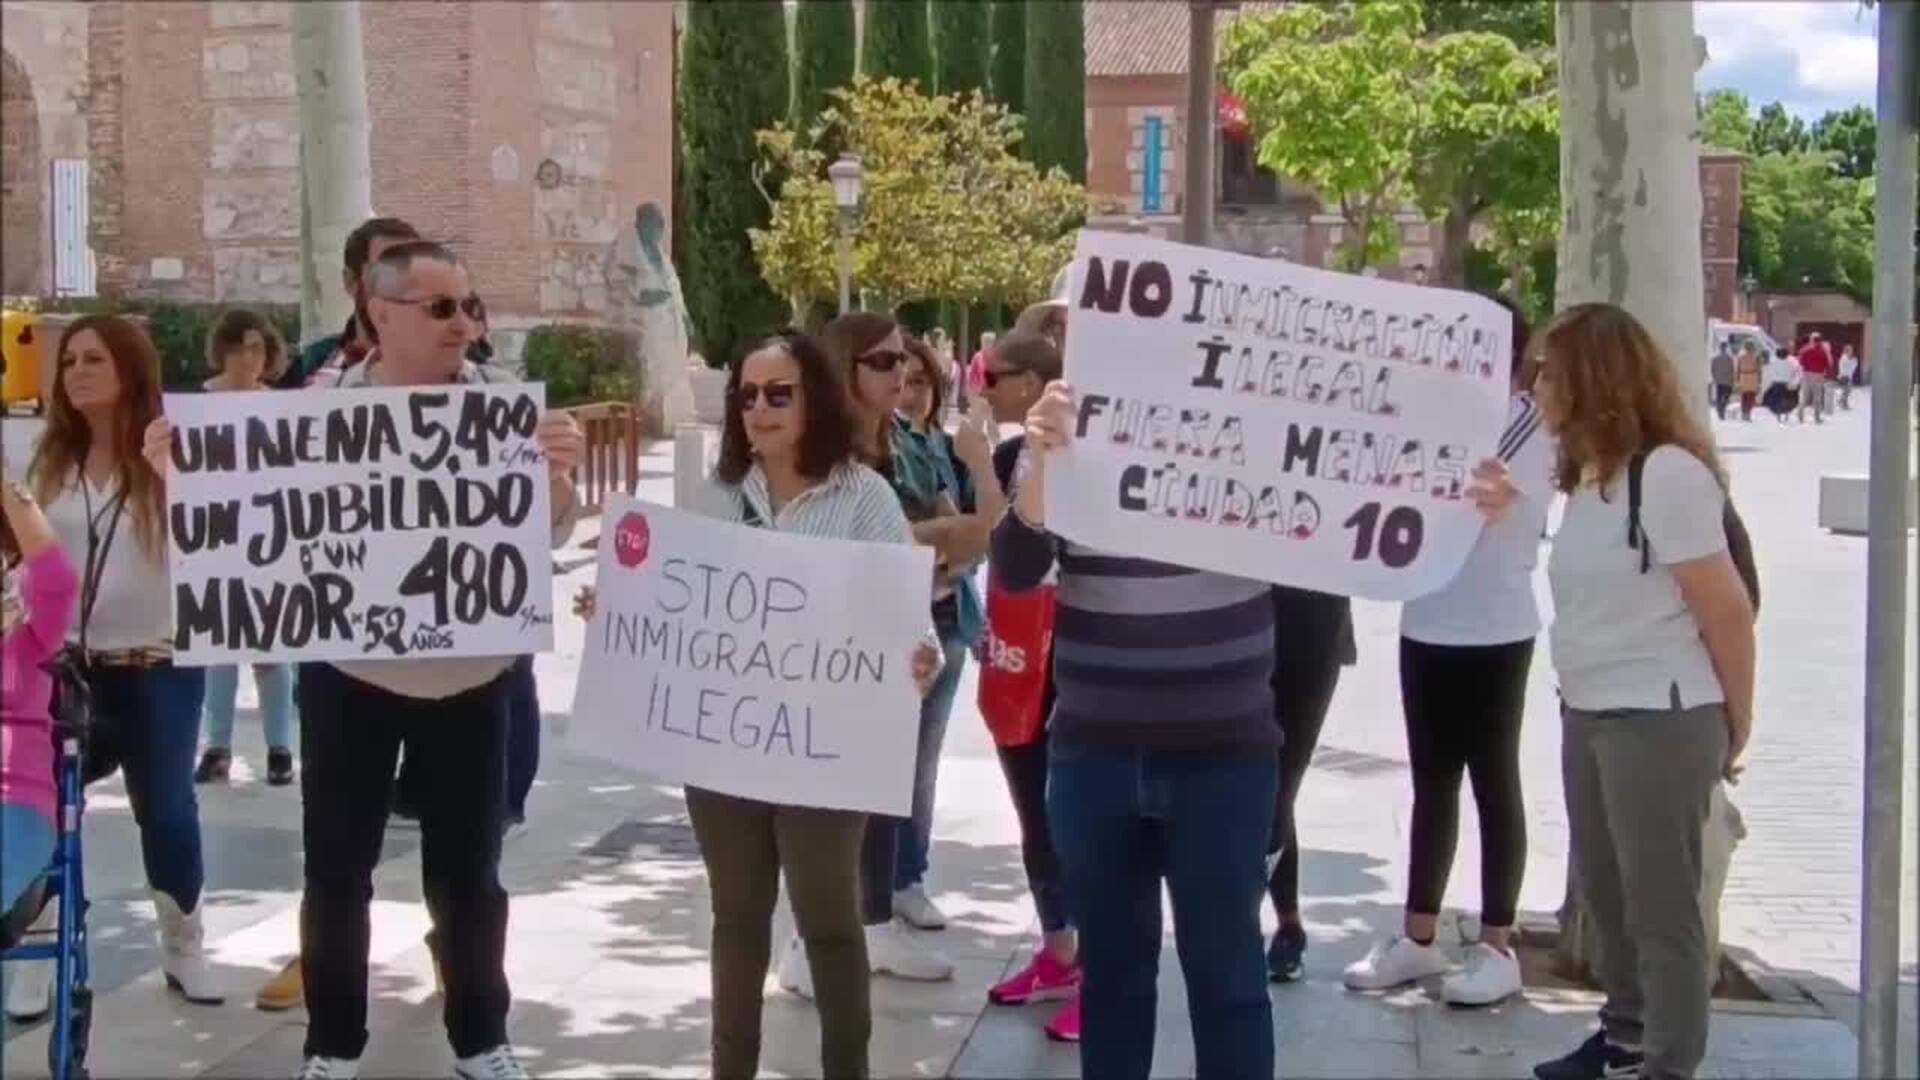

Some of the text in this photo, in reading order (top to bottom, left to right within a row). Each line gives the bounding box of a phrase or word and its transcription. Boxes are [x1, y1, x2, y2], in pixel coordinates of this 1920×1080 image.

[1080, 256, 1172, 318] NO
[1075, 395, 1466, 501] FUERA MENAS
[171, 500, 240, 554] UN
[1345, 502, 1423, 568] 10
[175, 572, 355, 652] MAYOR
[399, 536, 528, 625] 480
[658, 558, 808, 631] STOP
[604, 611, 884, 684] INMIGRACIÓN
[647, 672, 840, 759] ILEGAL
